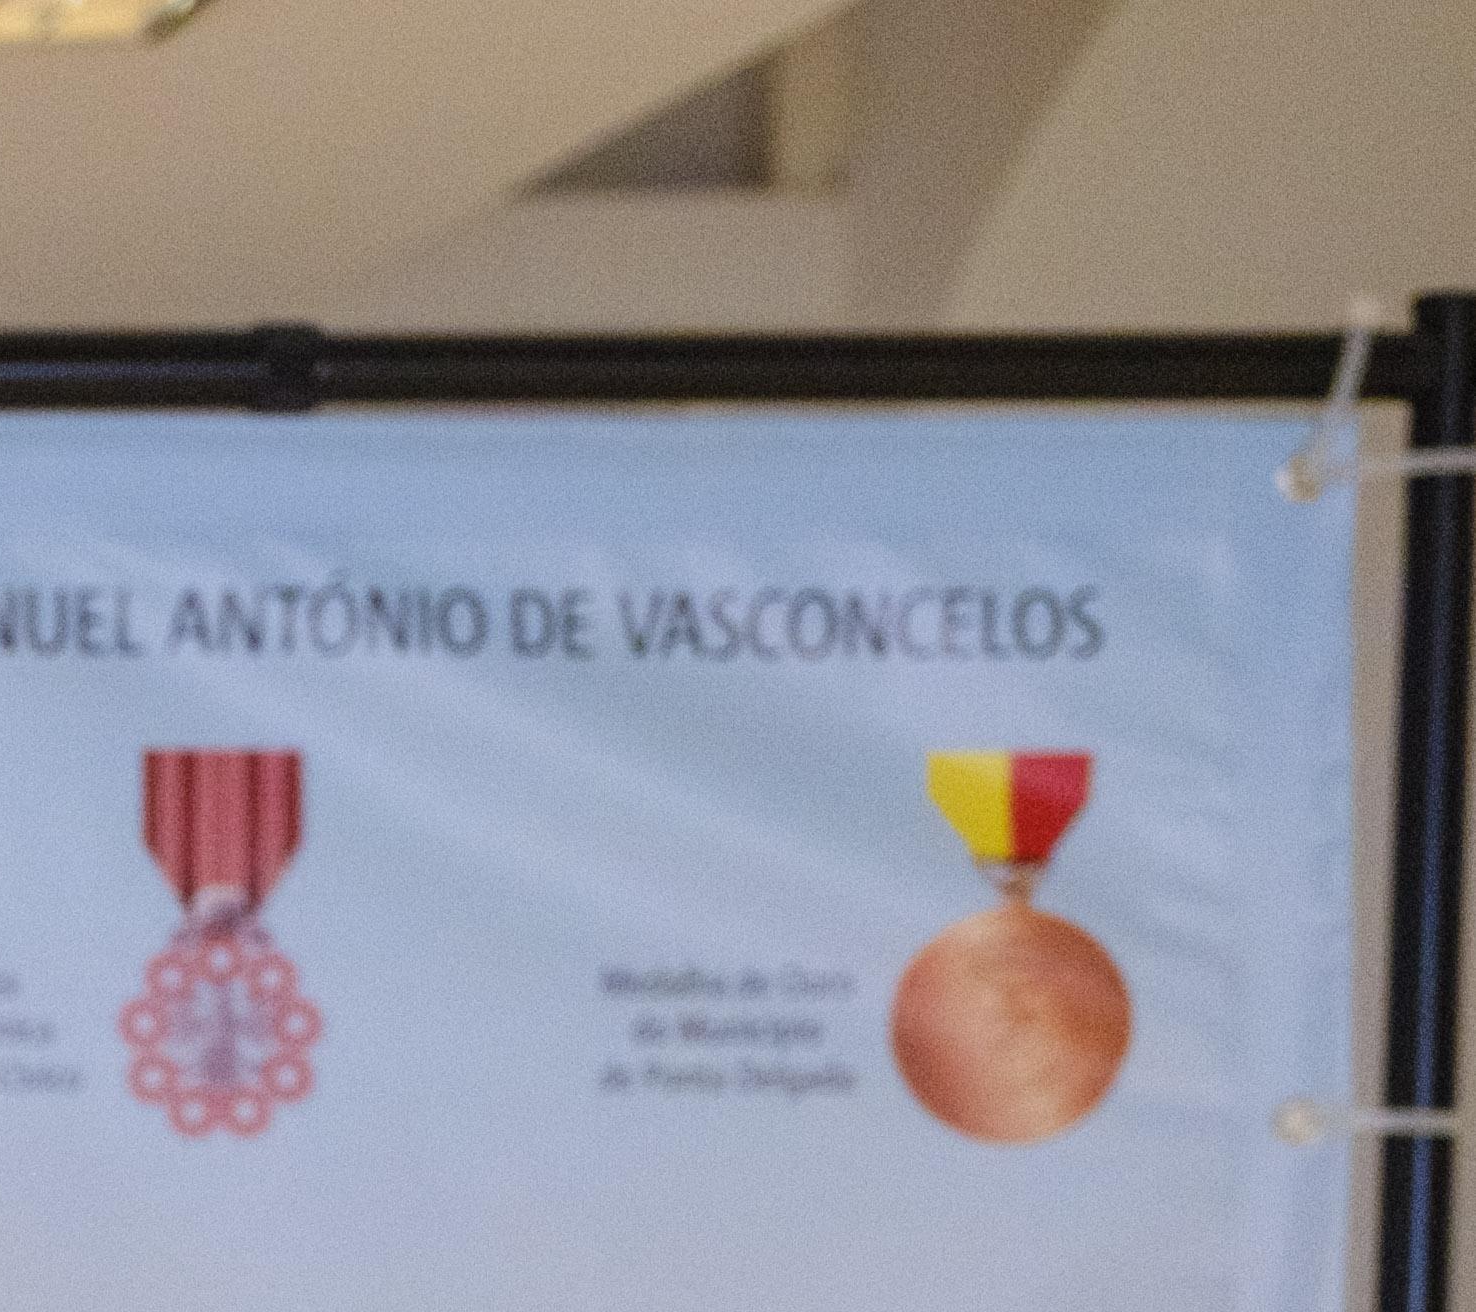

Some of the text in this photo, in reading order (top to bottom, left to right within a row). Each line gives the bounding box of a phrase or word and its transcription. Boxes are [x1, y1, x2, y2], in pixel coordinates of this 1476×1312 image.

[168, 566, 491, 661] ANTÓNIO
[505, 585, 596, 663] DE
[622, 582, 1108, 664] VASCONCELOS
